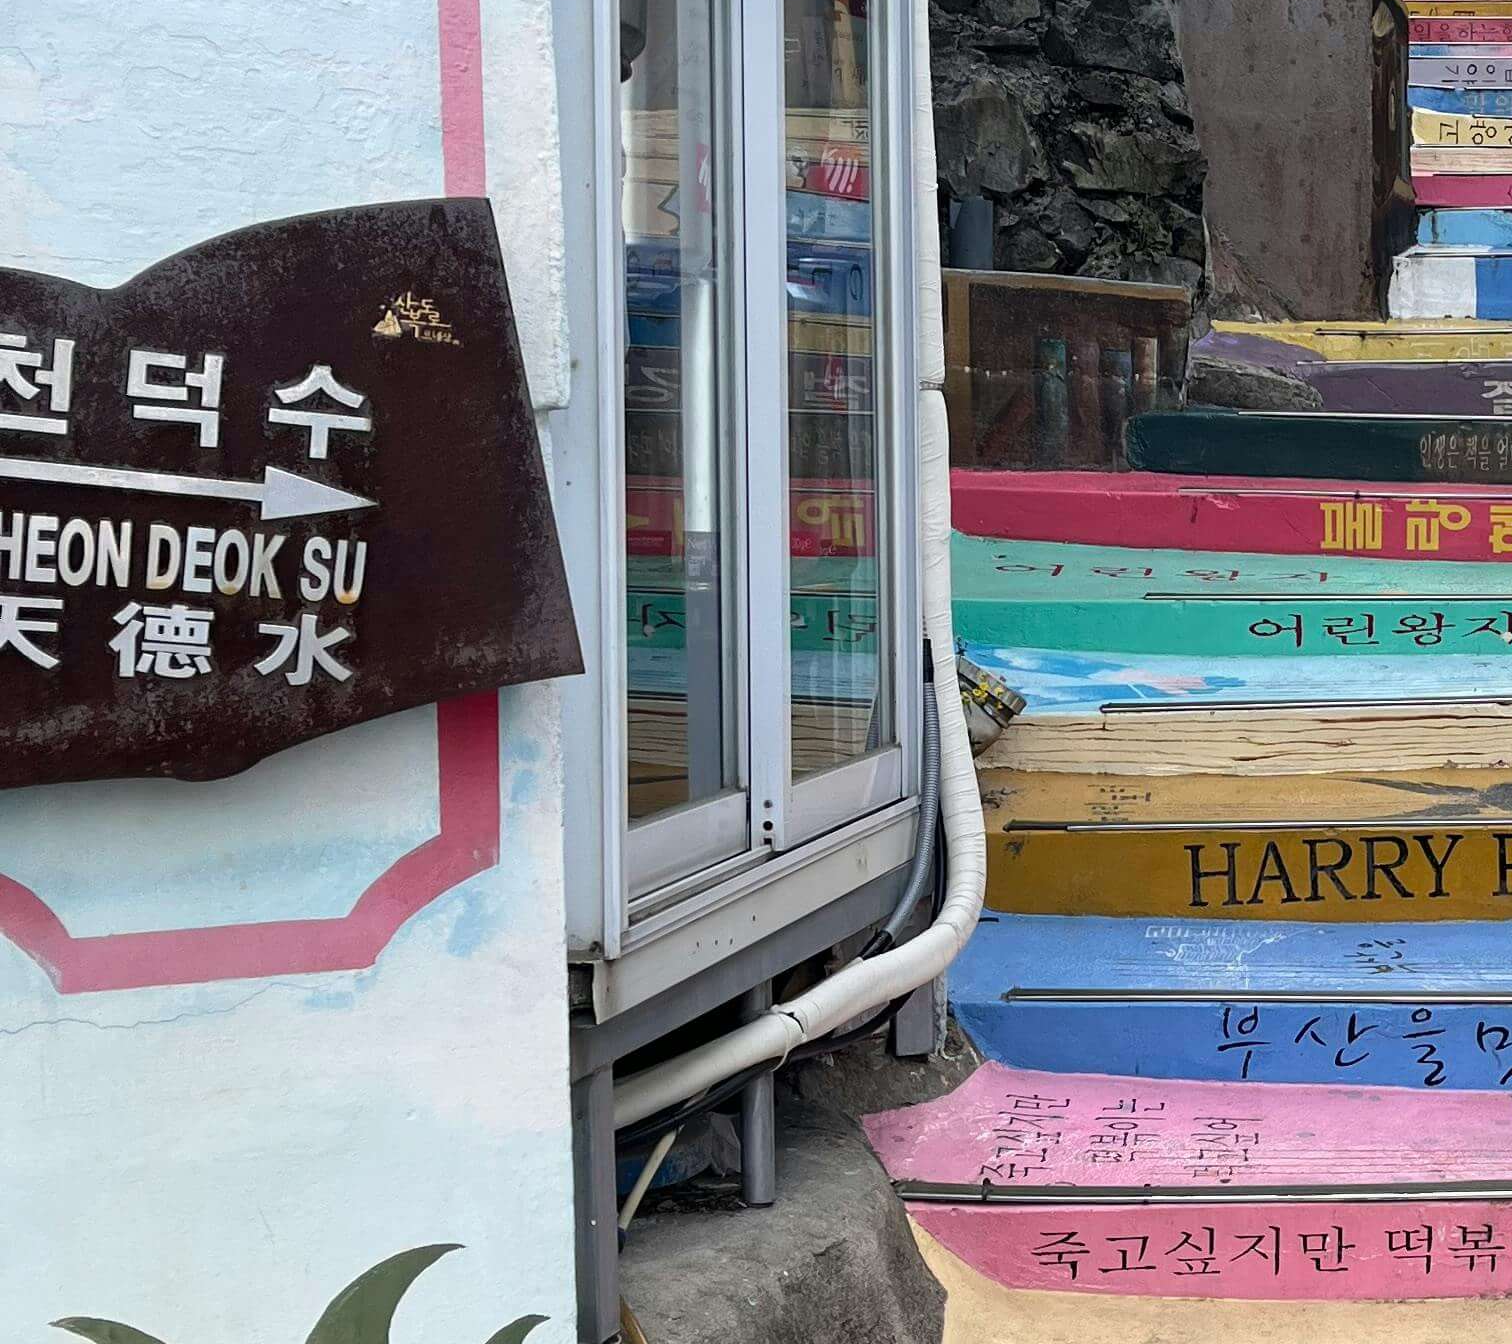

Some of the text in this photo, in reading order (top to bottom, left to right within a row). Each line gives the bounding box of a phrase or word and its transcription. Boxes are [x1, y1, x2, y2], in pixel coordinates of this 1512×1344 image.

[146, 523, 287, 601] DEOK
[300, 535, 368, 605] SU
[1184, 830, 1480, 908] HARRY
